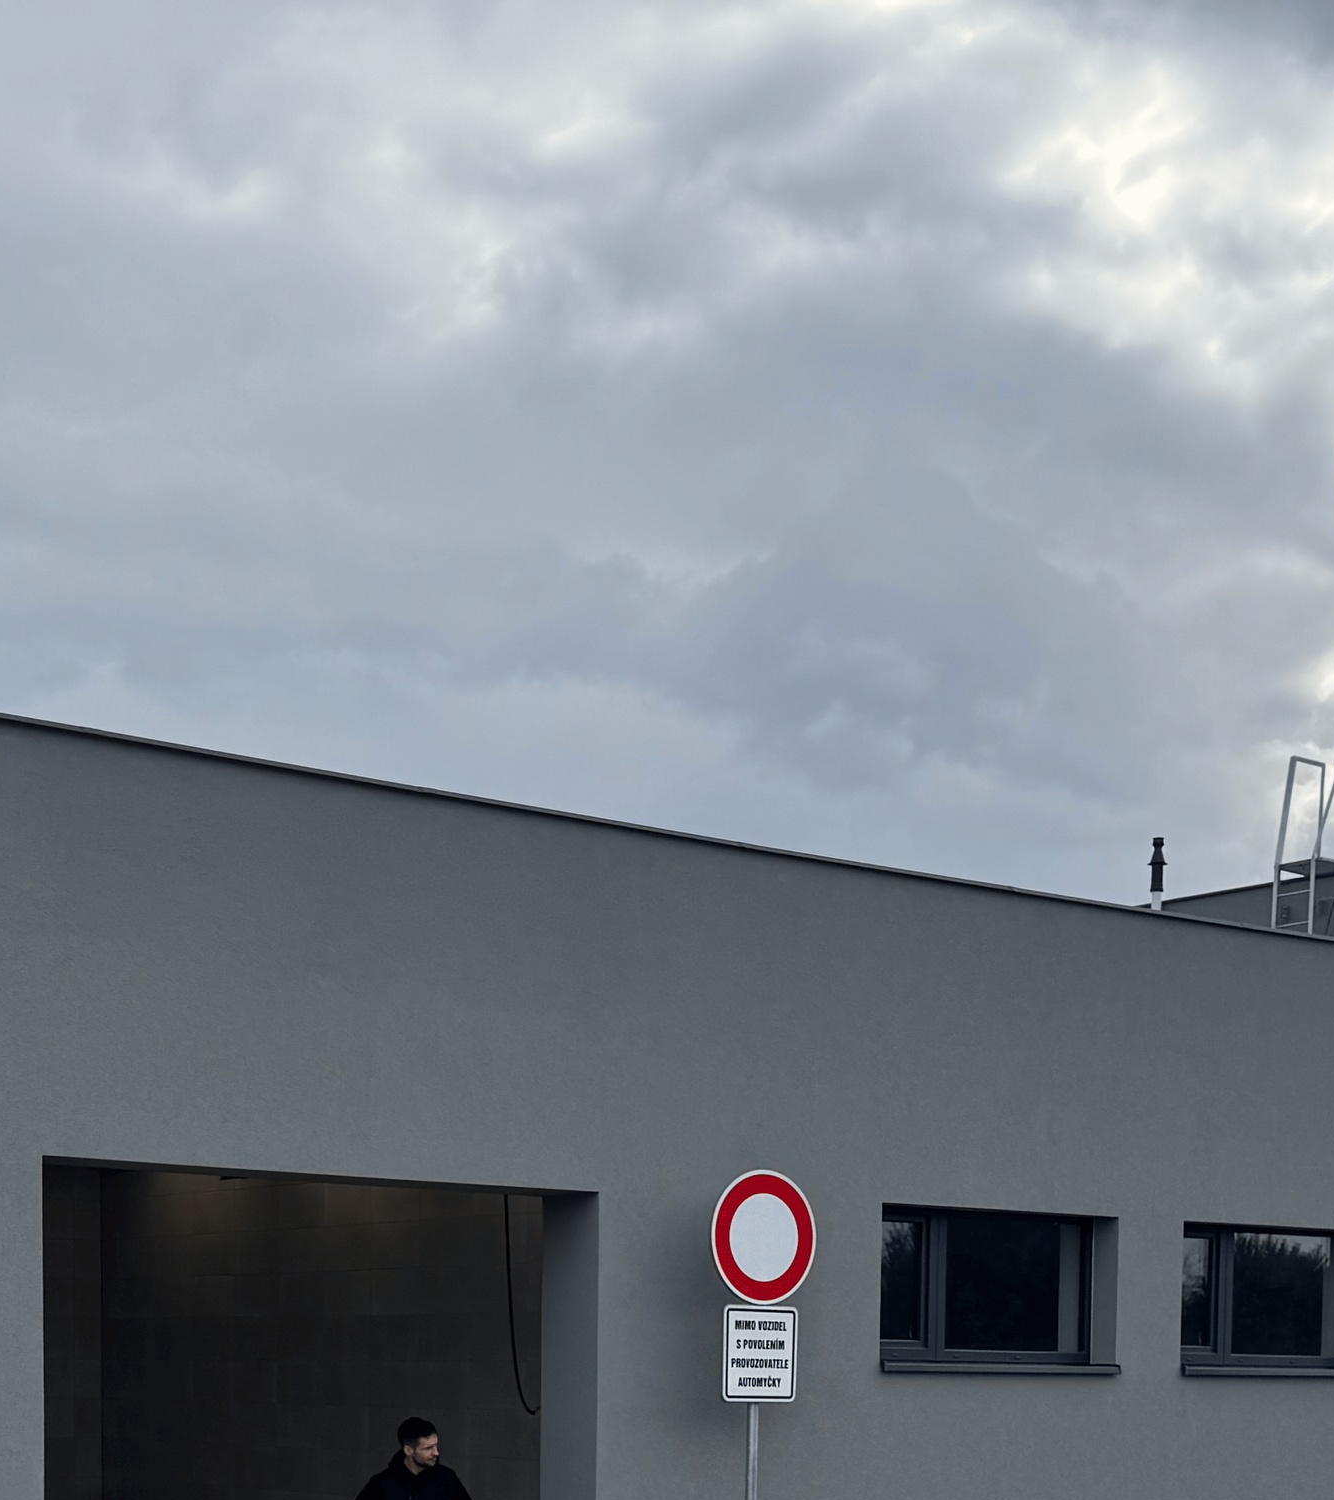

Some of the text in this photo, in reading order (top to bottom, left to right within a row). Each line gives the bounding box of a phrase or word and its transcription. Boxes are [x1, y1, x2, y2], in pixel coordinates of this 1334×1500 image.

[735, 1320, 787, 1331] MIMO VOZIDEL
[736, 1338, 784, 1350] S POVOLENÍM
[731, 1358, 788, 1369] PROVOZOVATELE
[738, 1376, 781, 1387] AUTOMYČKY
